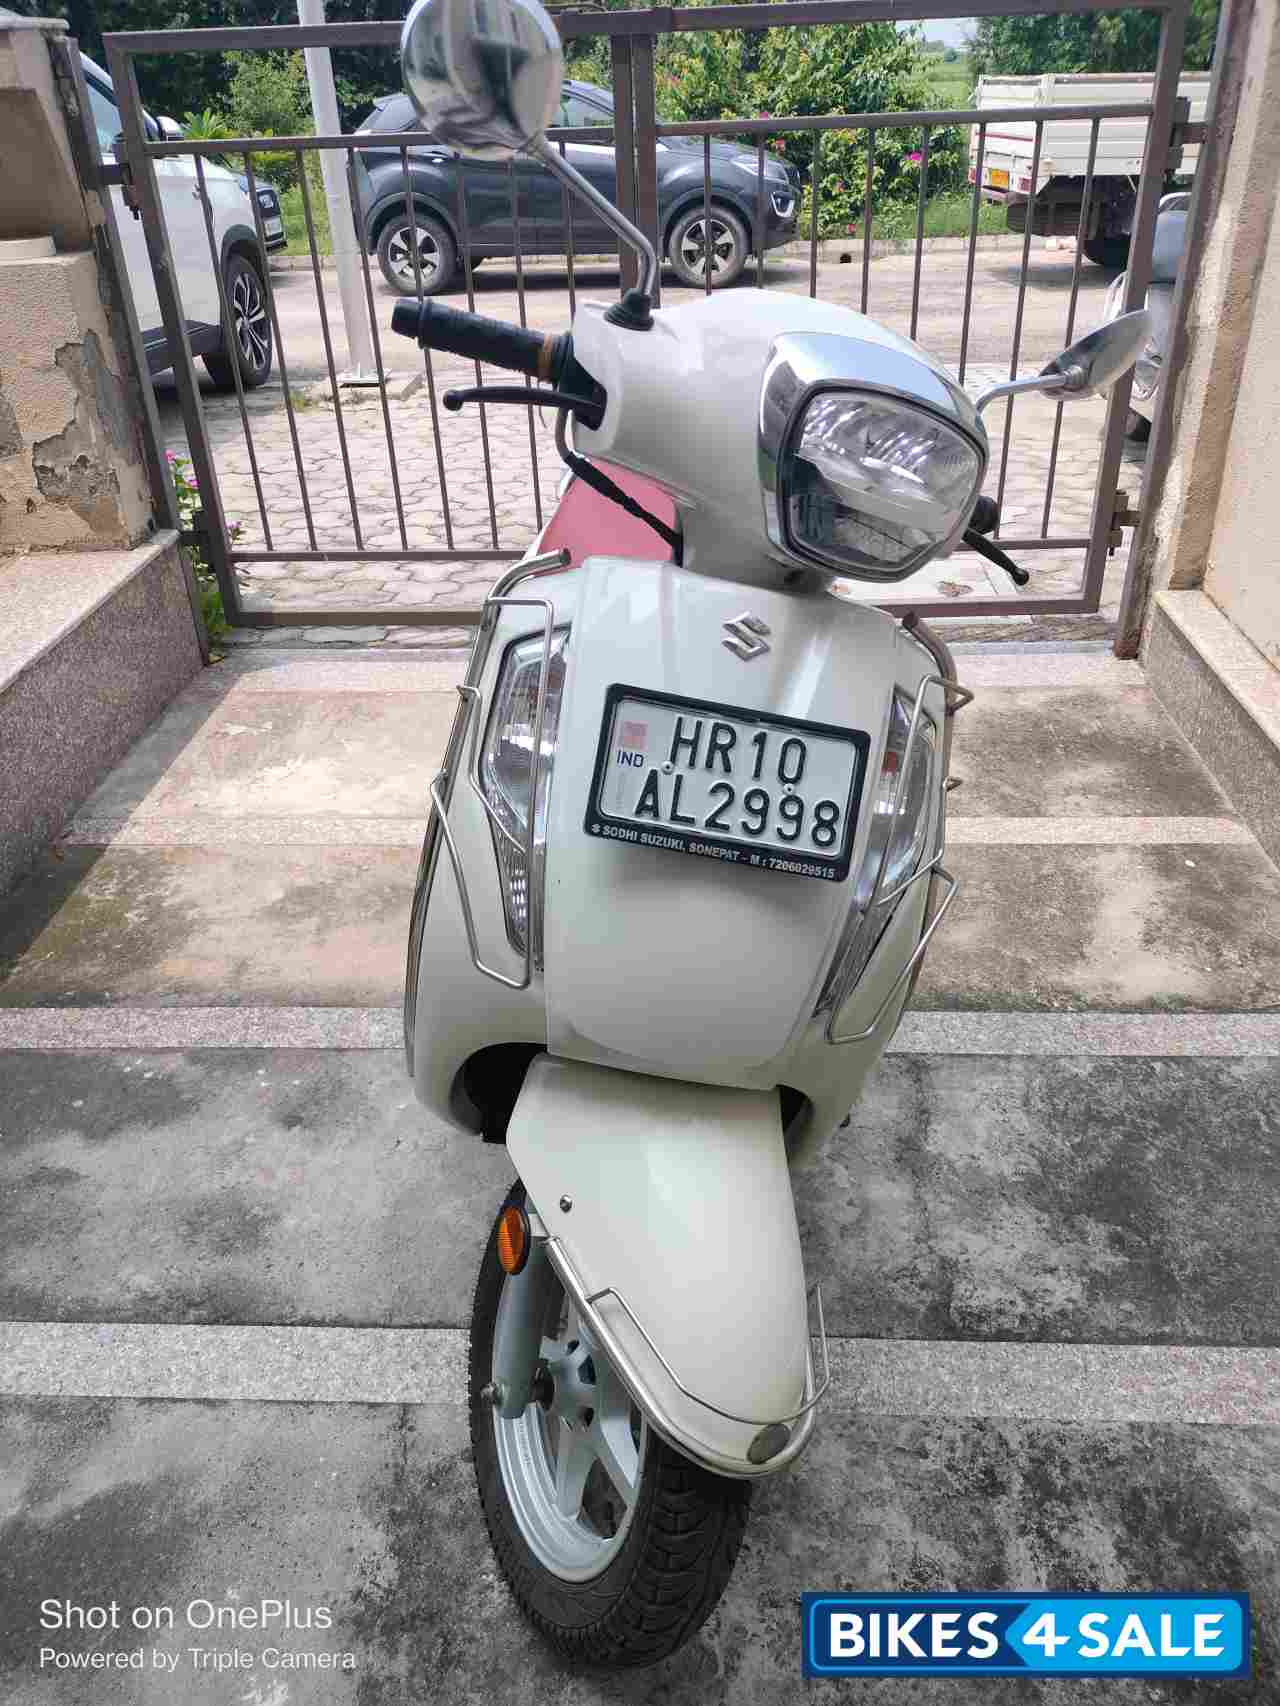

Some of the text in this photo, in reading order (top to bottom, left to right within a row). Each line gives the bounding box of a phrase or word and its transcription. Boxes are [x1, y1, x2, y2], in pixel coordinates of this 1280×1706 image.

[616, 749, 644, 767] IND
[602, 825, 638, 841] SODHI
[689, 842, 740, 861] SONEPAT
